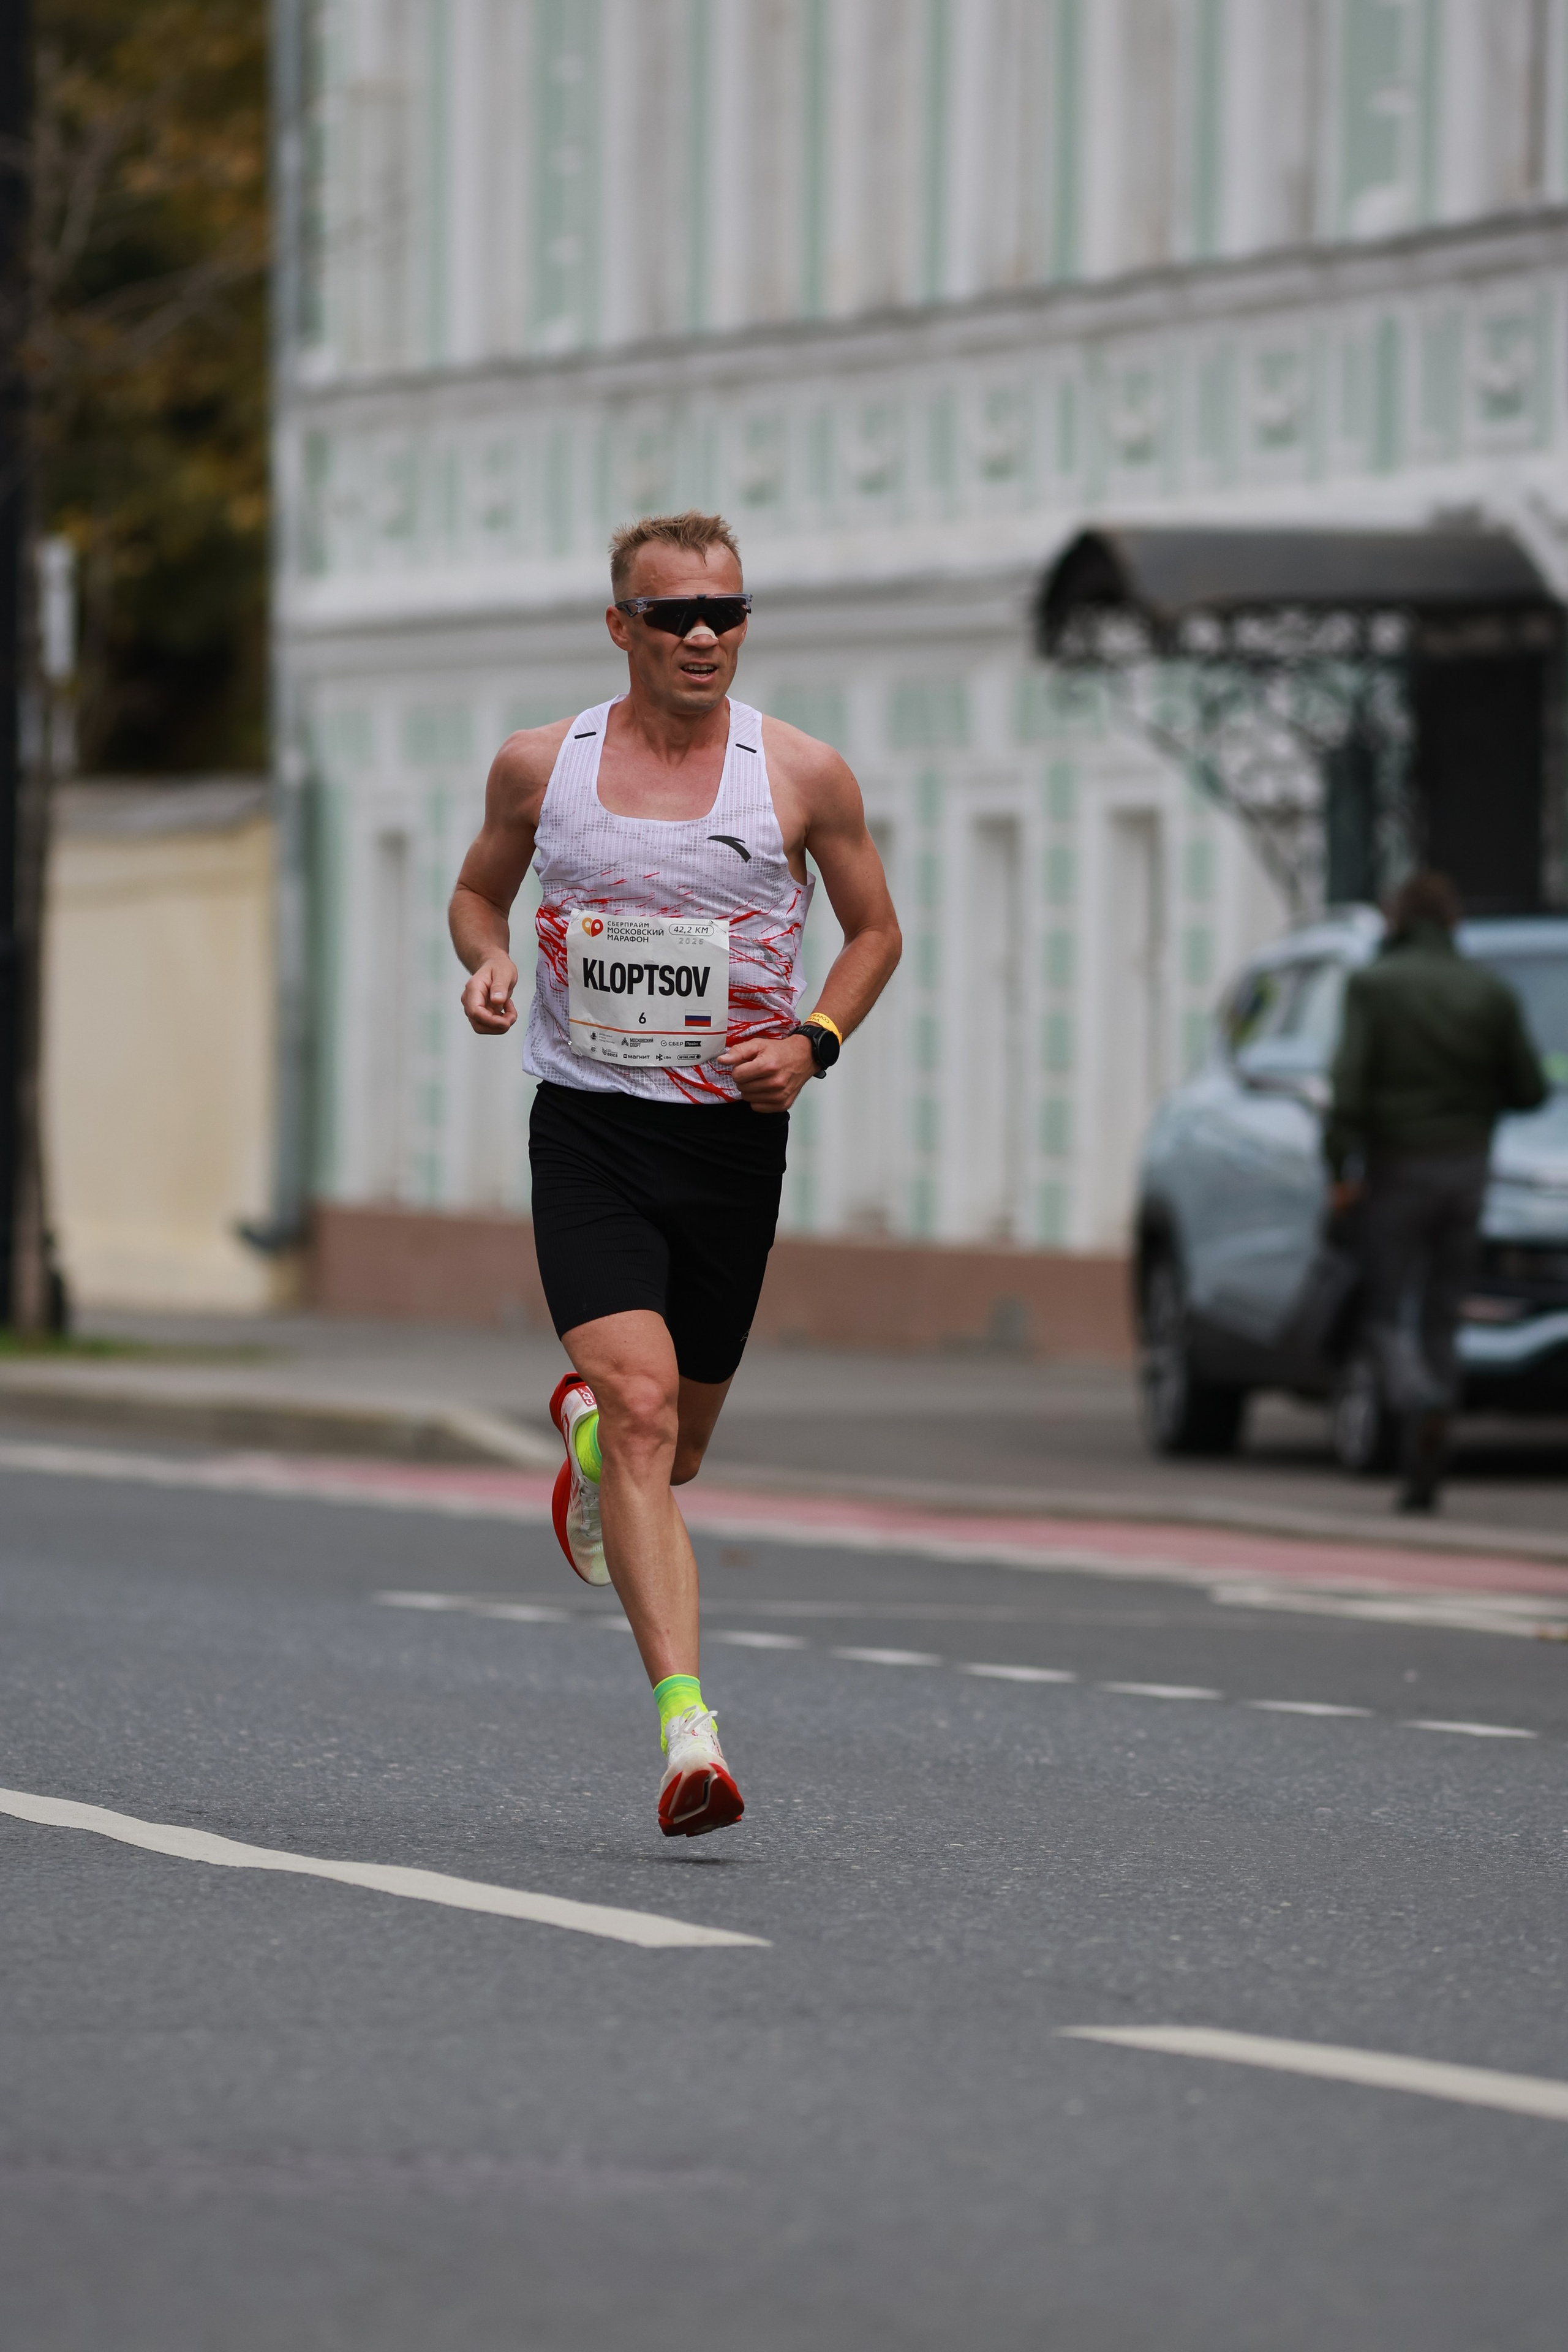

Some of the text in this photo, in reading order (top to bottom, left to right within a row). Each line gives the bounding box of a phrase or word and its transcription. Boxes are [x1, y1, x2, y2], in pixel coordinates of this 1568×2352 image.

[607, 927, 664, 936] МОСКОВСКИЙ
[607, 934, 649, 943] МАРАФОН
[582, 957, 710, 997] KLOPTSOV
[638, 1012, 647, 1024] 6
